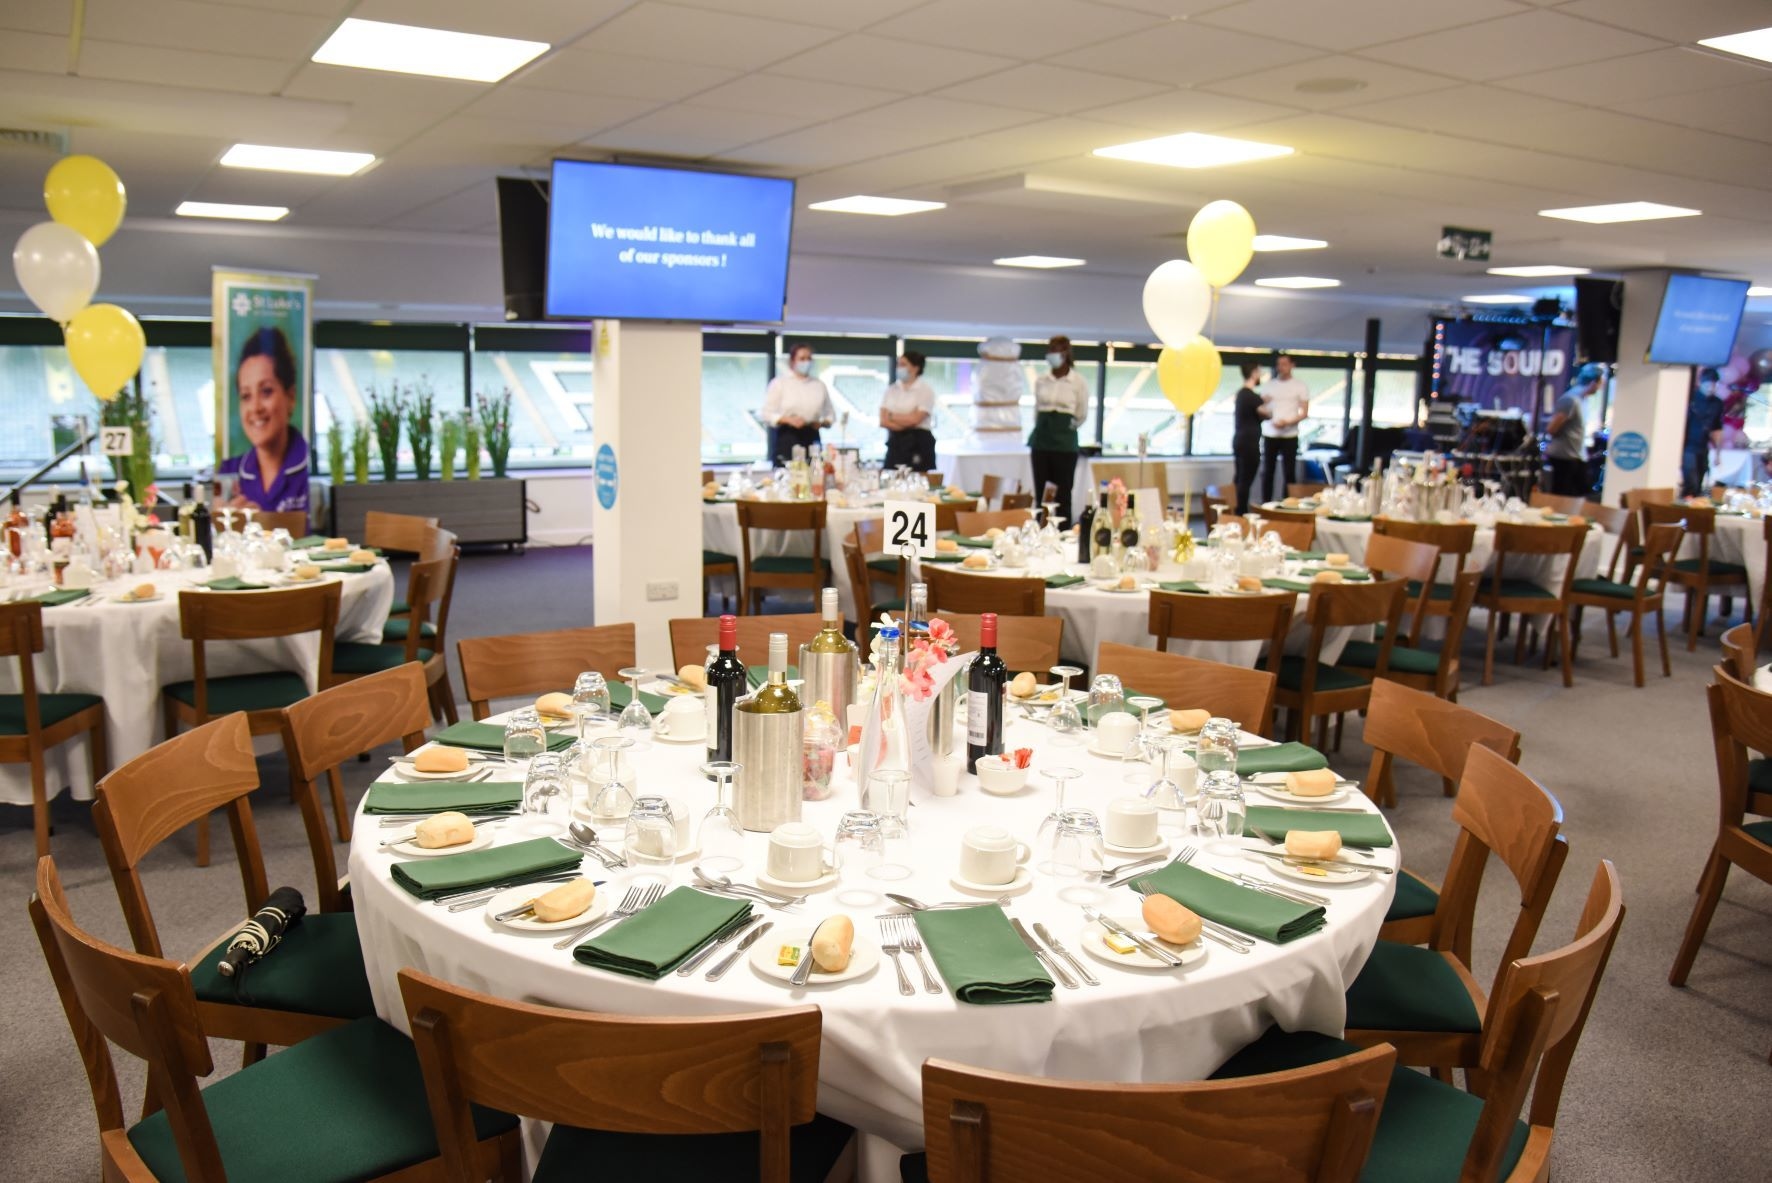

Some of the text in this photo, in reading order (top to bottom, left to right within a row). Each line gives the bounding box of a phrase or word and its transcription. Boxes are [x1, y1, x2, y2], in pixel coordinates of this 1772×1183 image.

[591, 223, 756, 247] We would like to thank all
[619, 247, 636, 263] of
[635, 252, 660, 264] our
[661, 252, 720, 268] sponsors
[105, 432, 126, 450] 27
[892, 510, 928, 547] 24
